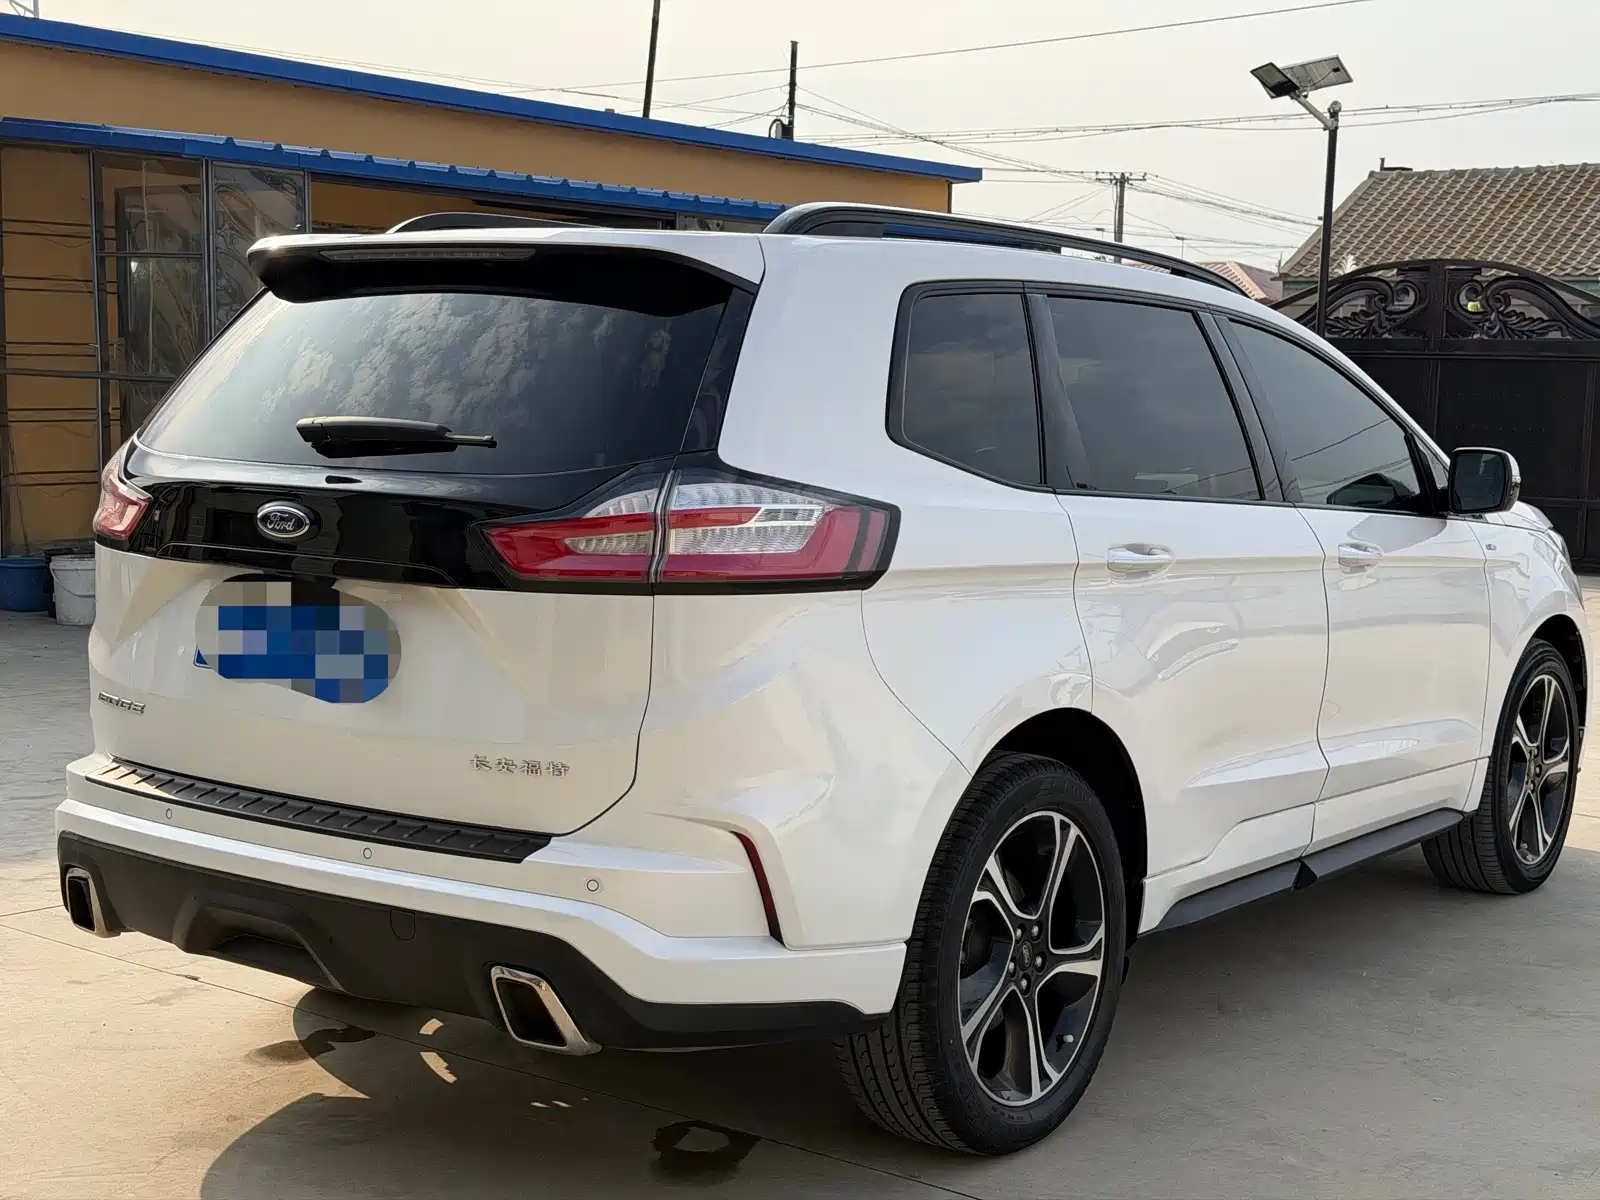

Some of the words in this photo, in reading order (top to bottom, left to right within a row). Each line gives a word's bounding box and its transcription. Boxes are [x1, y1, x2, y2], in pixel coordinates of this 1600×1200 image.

[267, 512, 296, 531] Ford
[469, 753, 571, 777] 长安福特
